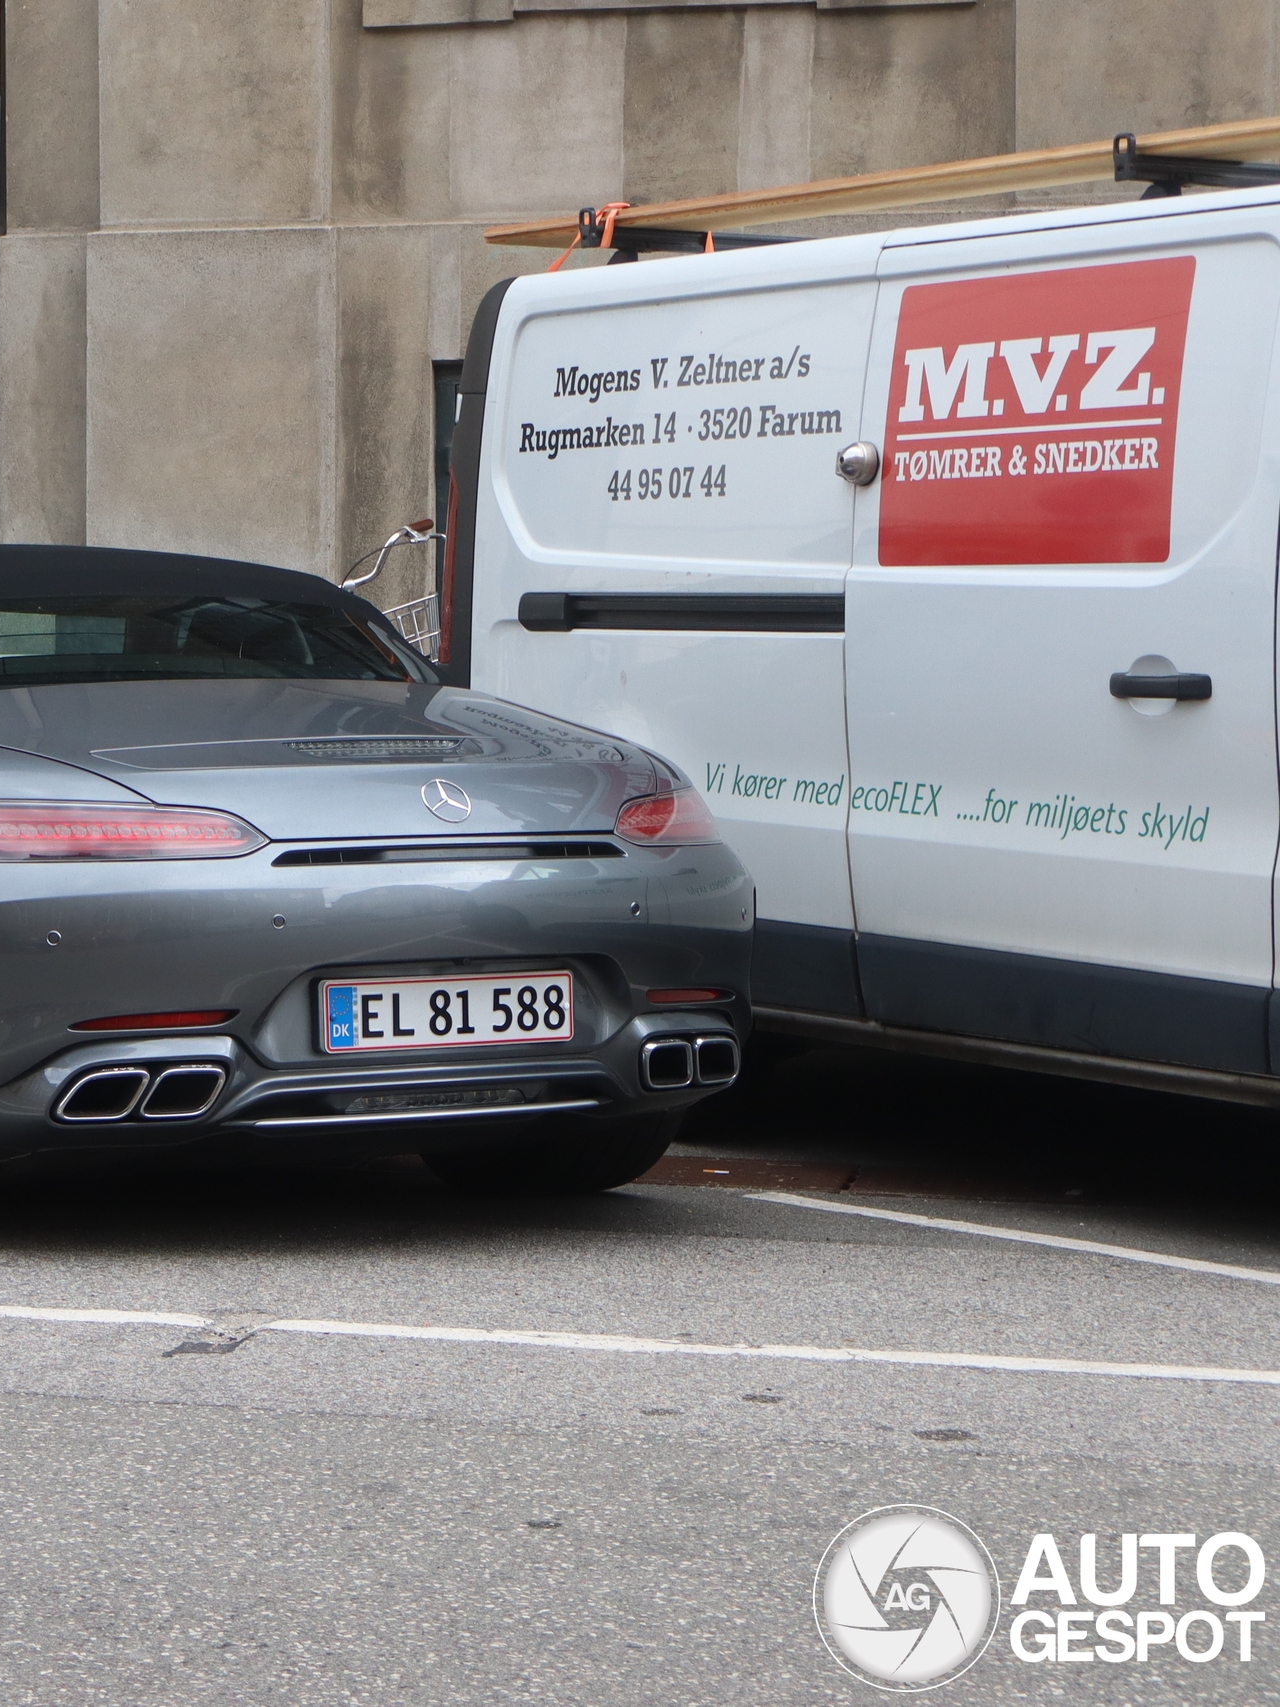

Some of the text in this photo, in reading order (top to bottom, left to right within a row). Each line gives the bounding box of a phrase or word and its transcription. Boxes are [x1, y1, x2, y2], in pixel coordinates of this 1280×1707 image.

[553, 345, 811, 404] Mogens V. Zeltner a/s
[898, 326, 1165, 423] M.V.Z.
[519, 416, 645, 460] Rugmarken
[652, 411, 677, 444] 14
[698, 406, 752, 442] 3520
[756, 405, 843, 438] Farum
[894, 437, 1159, 482] TØMRER & SNEDKER
[607, 464, 727, 501] 44 95 07 44
[706, 762, 726, 794] Vi
[731, 764, 788, 800] kører
[792, 774, 845, 806] med
[851, 781, 943, 817] ecoFLEX
[1025, 794, 1128, 841] miljøets
[1138, 802, 1210, 851] skyld
[332, 1023, 350, 1038] DK
[361, 984, 566, 1038] EL 81 588
